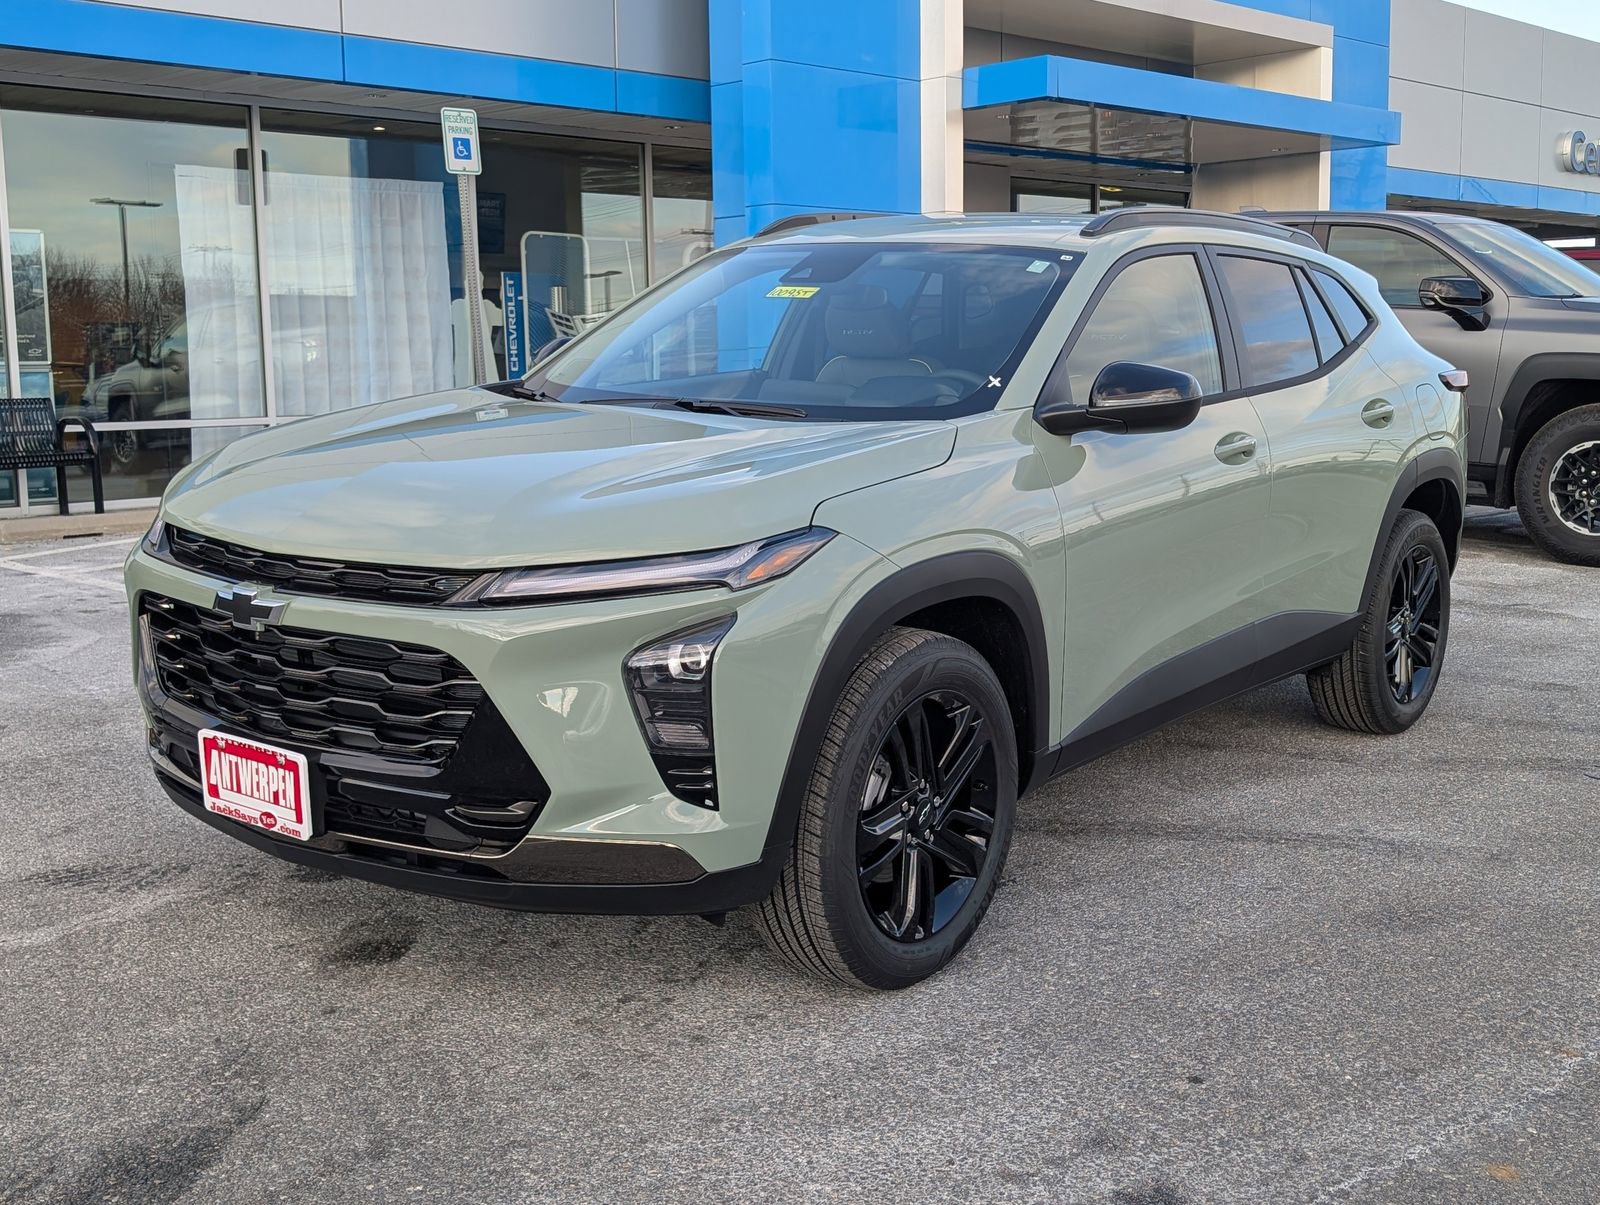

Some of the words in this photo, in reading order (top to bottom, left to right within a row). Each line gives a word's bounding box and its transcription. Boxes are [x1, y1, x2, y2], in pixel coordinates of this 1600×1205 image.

[444, 115, 474, 124] RESERVED
[448, 125, 473, 135] PARKING
[506, 276, 519, 372] CHEVROLET
[1531, 456, 1551, 525] WRANGLER
[209, 748, 296, 810] ANTWERPEN
[844, 688, 904, 818] GOODYEAR
